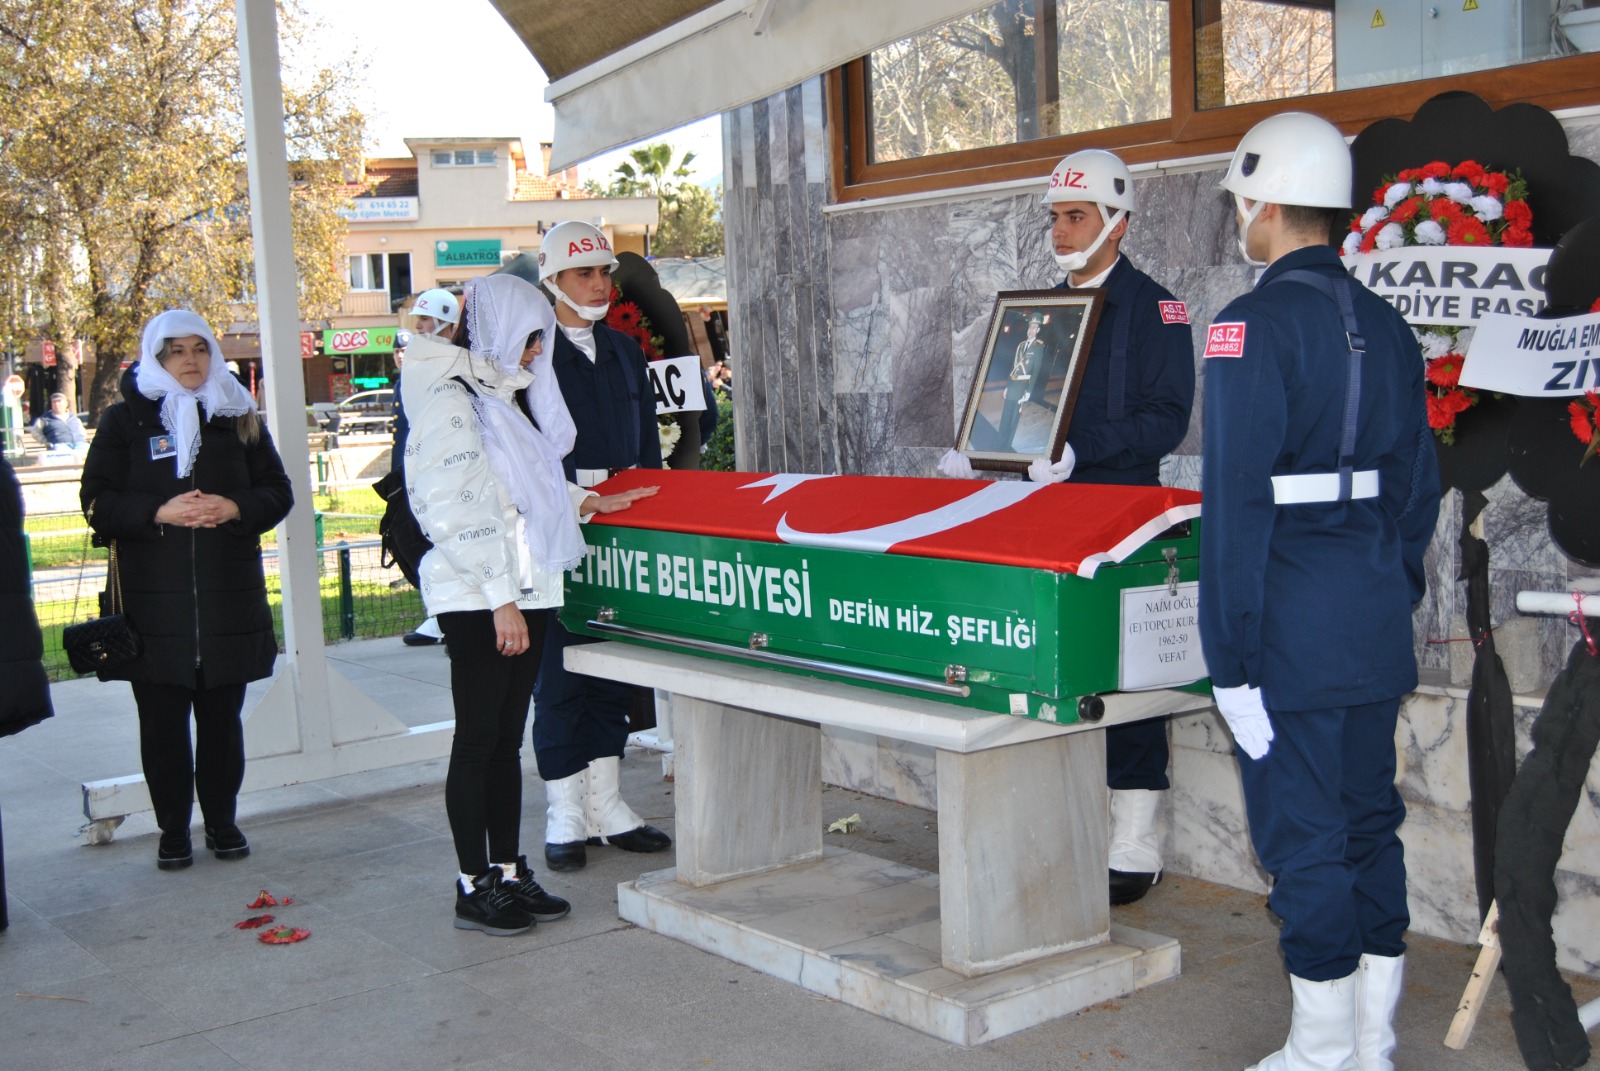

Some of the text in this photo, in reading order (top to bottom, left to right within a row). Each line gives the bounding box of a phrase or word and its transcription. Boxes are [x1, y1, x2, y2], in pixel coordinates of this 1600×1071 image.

[446, 251, 500, 261] ALBATROS
[1516, 322, 1577, 352] MUĞLA
[458, 525, 497, 542] HOLMUIM
[656, 552, 812, 618] BELEDİYESİ
[829, 598, 890, 629] DEFİN
[896, 604, 940, 637] HİZ.
[1144, 618, 1174, 631] TOPÇU
[1158, 650, 1187, 663] VEFAT
